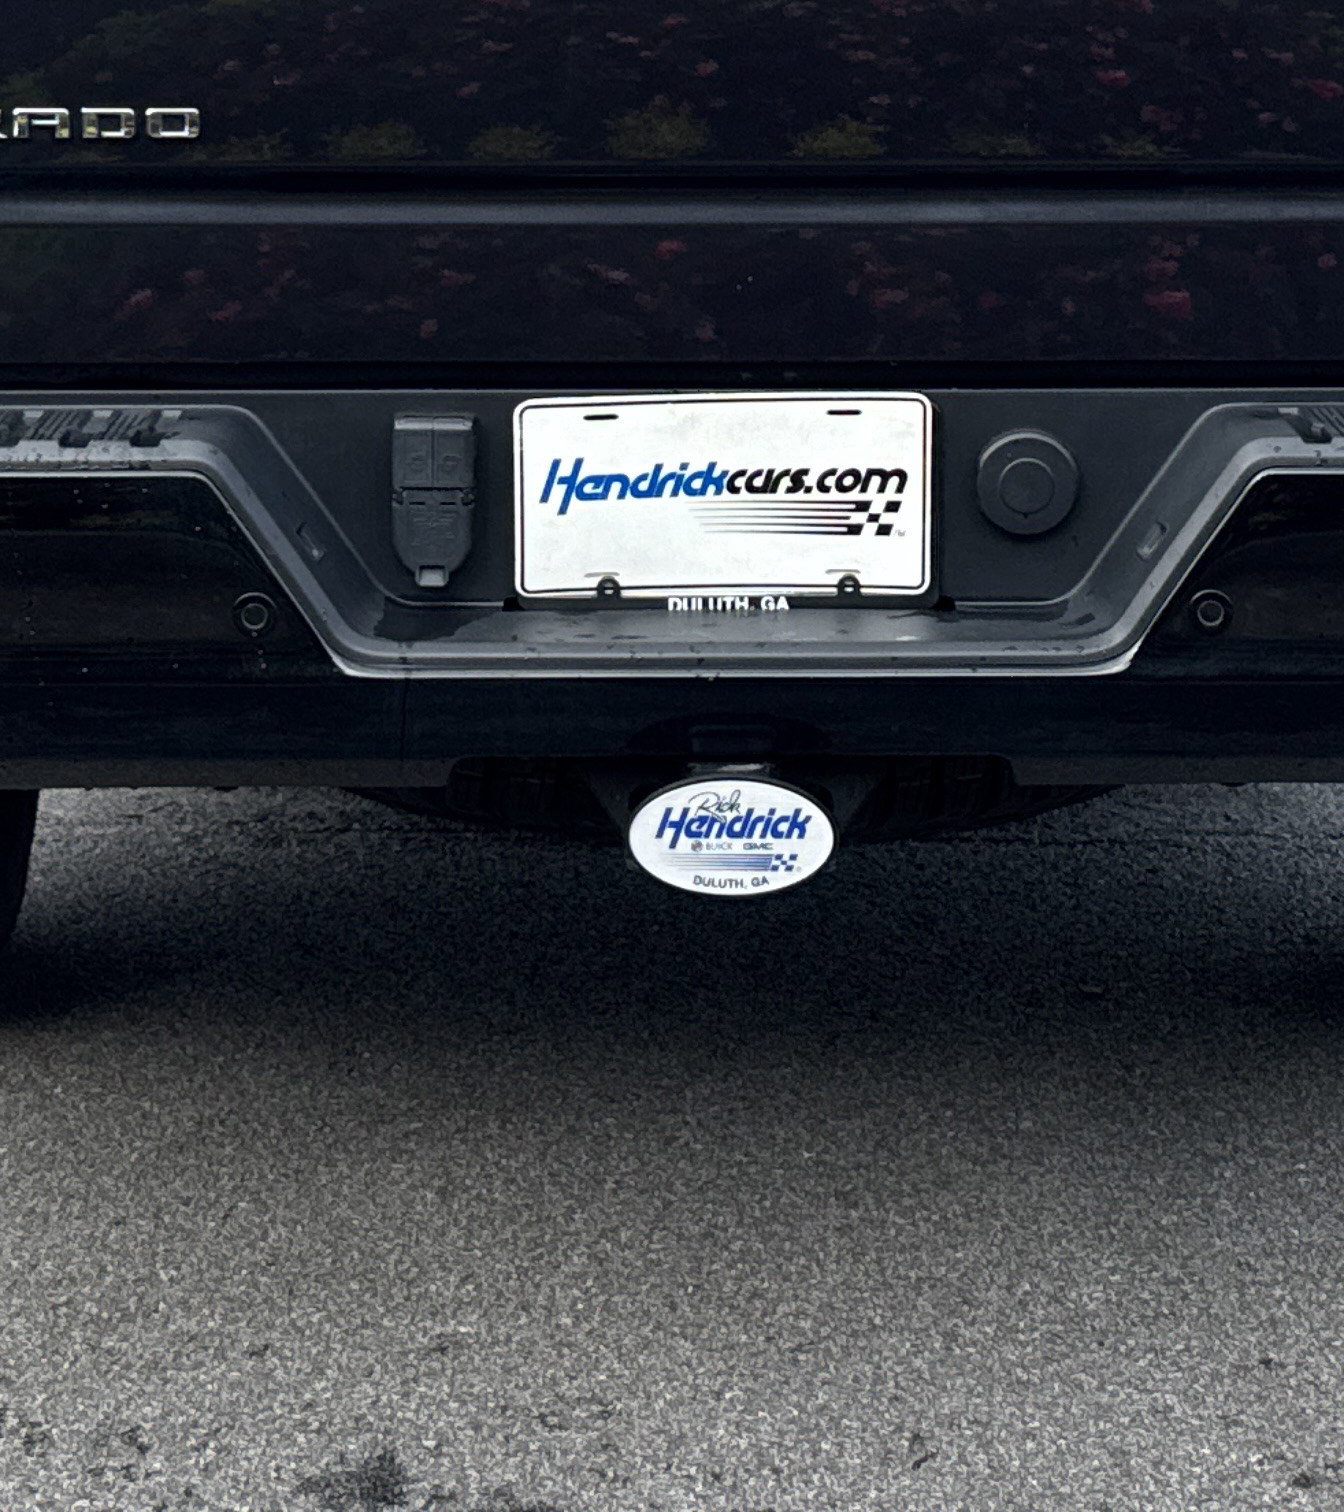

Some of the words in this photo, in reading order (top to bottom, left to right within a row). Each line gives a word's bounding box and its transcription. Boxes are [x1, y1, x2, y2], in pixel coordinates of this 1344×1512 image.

[538, 457, 908, 516] Hendrickcars.com
[760, 595, 790, 611] GA
[688, 789, 742, 822] Rick
[655, 807, 813, 849] Hendrick
[742, 841, 774, 851] GMC
[751, 874, 770, 888] GA
